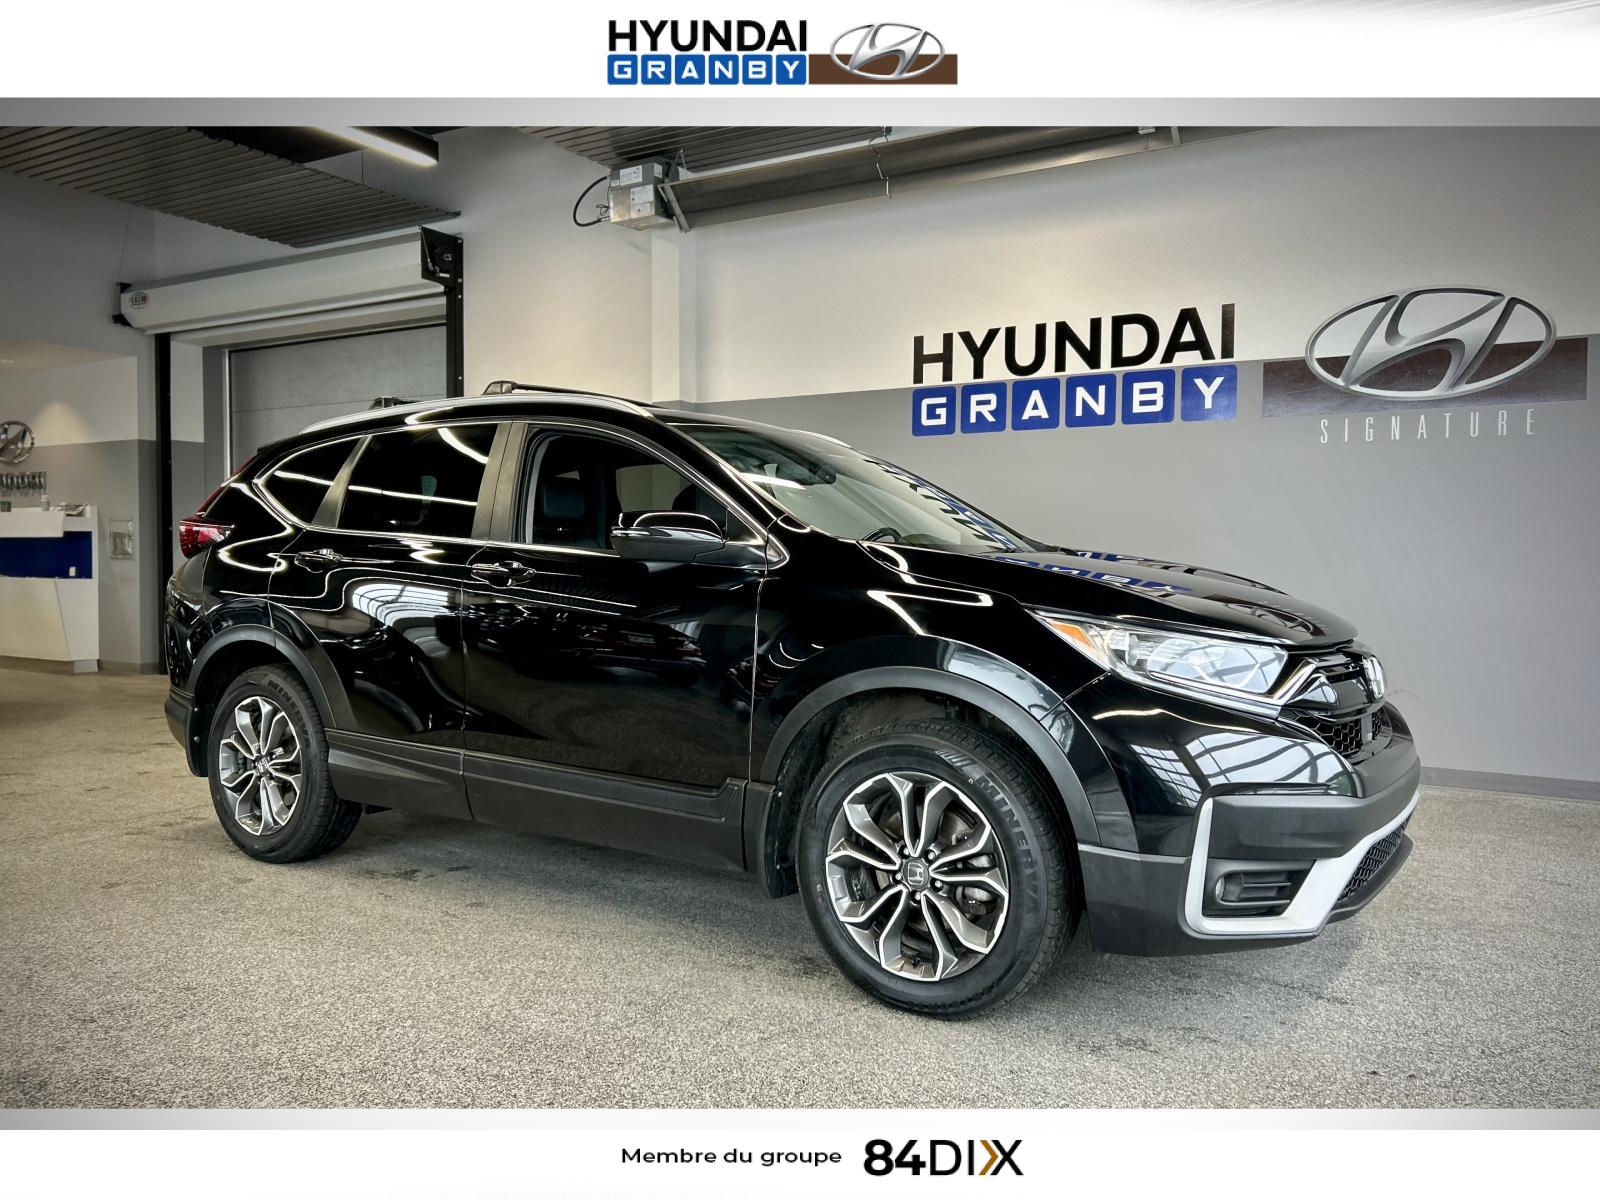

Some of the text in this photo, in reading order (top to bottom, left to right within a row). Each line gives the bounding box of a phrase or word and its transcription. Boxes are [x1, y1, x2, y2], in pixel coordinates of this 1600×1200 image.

[913, 303, 1236, 385] HYUNDAI
[920, 376, 1225, 426] GRANBY
[1320, 408, 1535, 444] SIGNATURE
